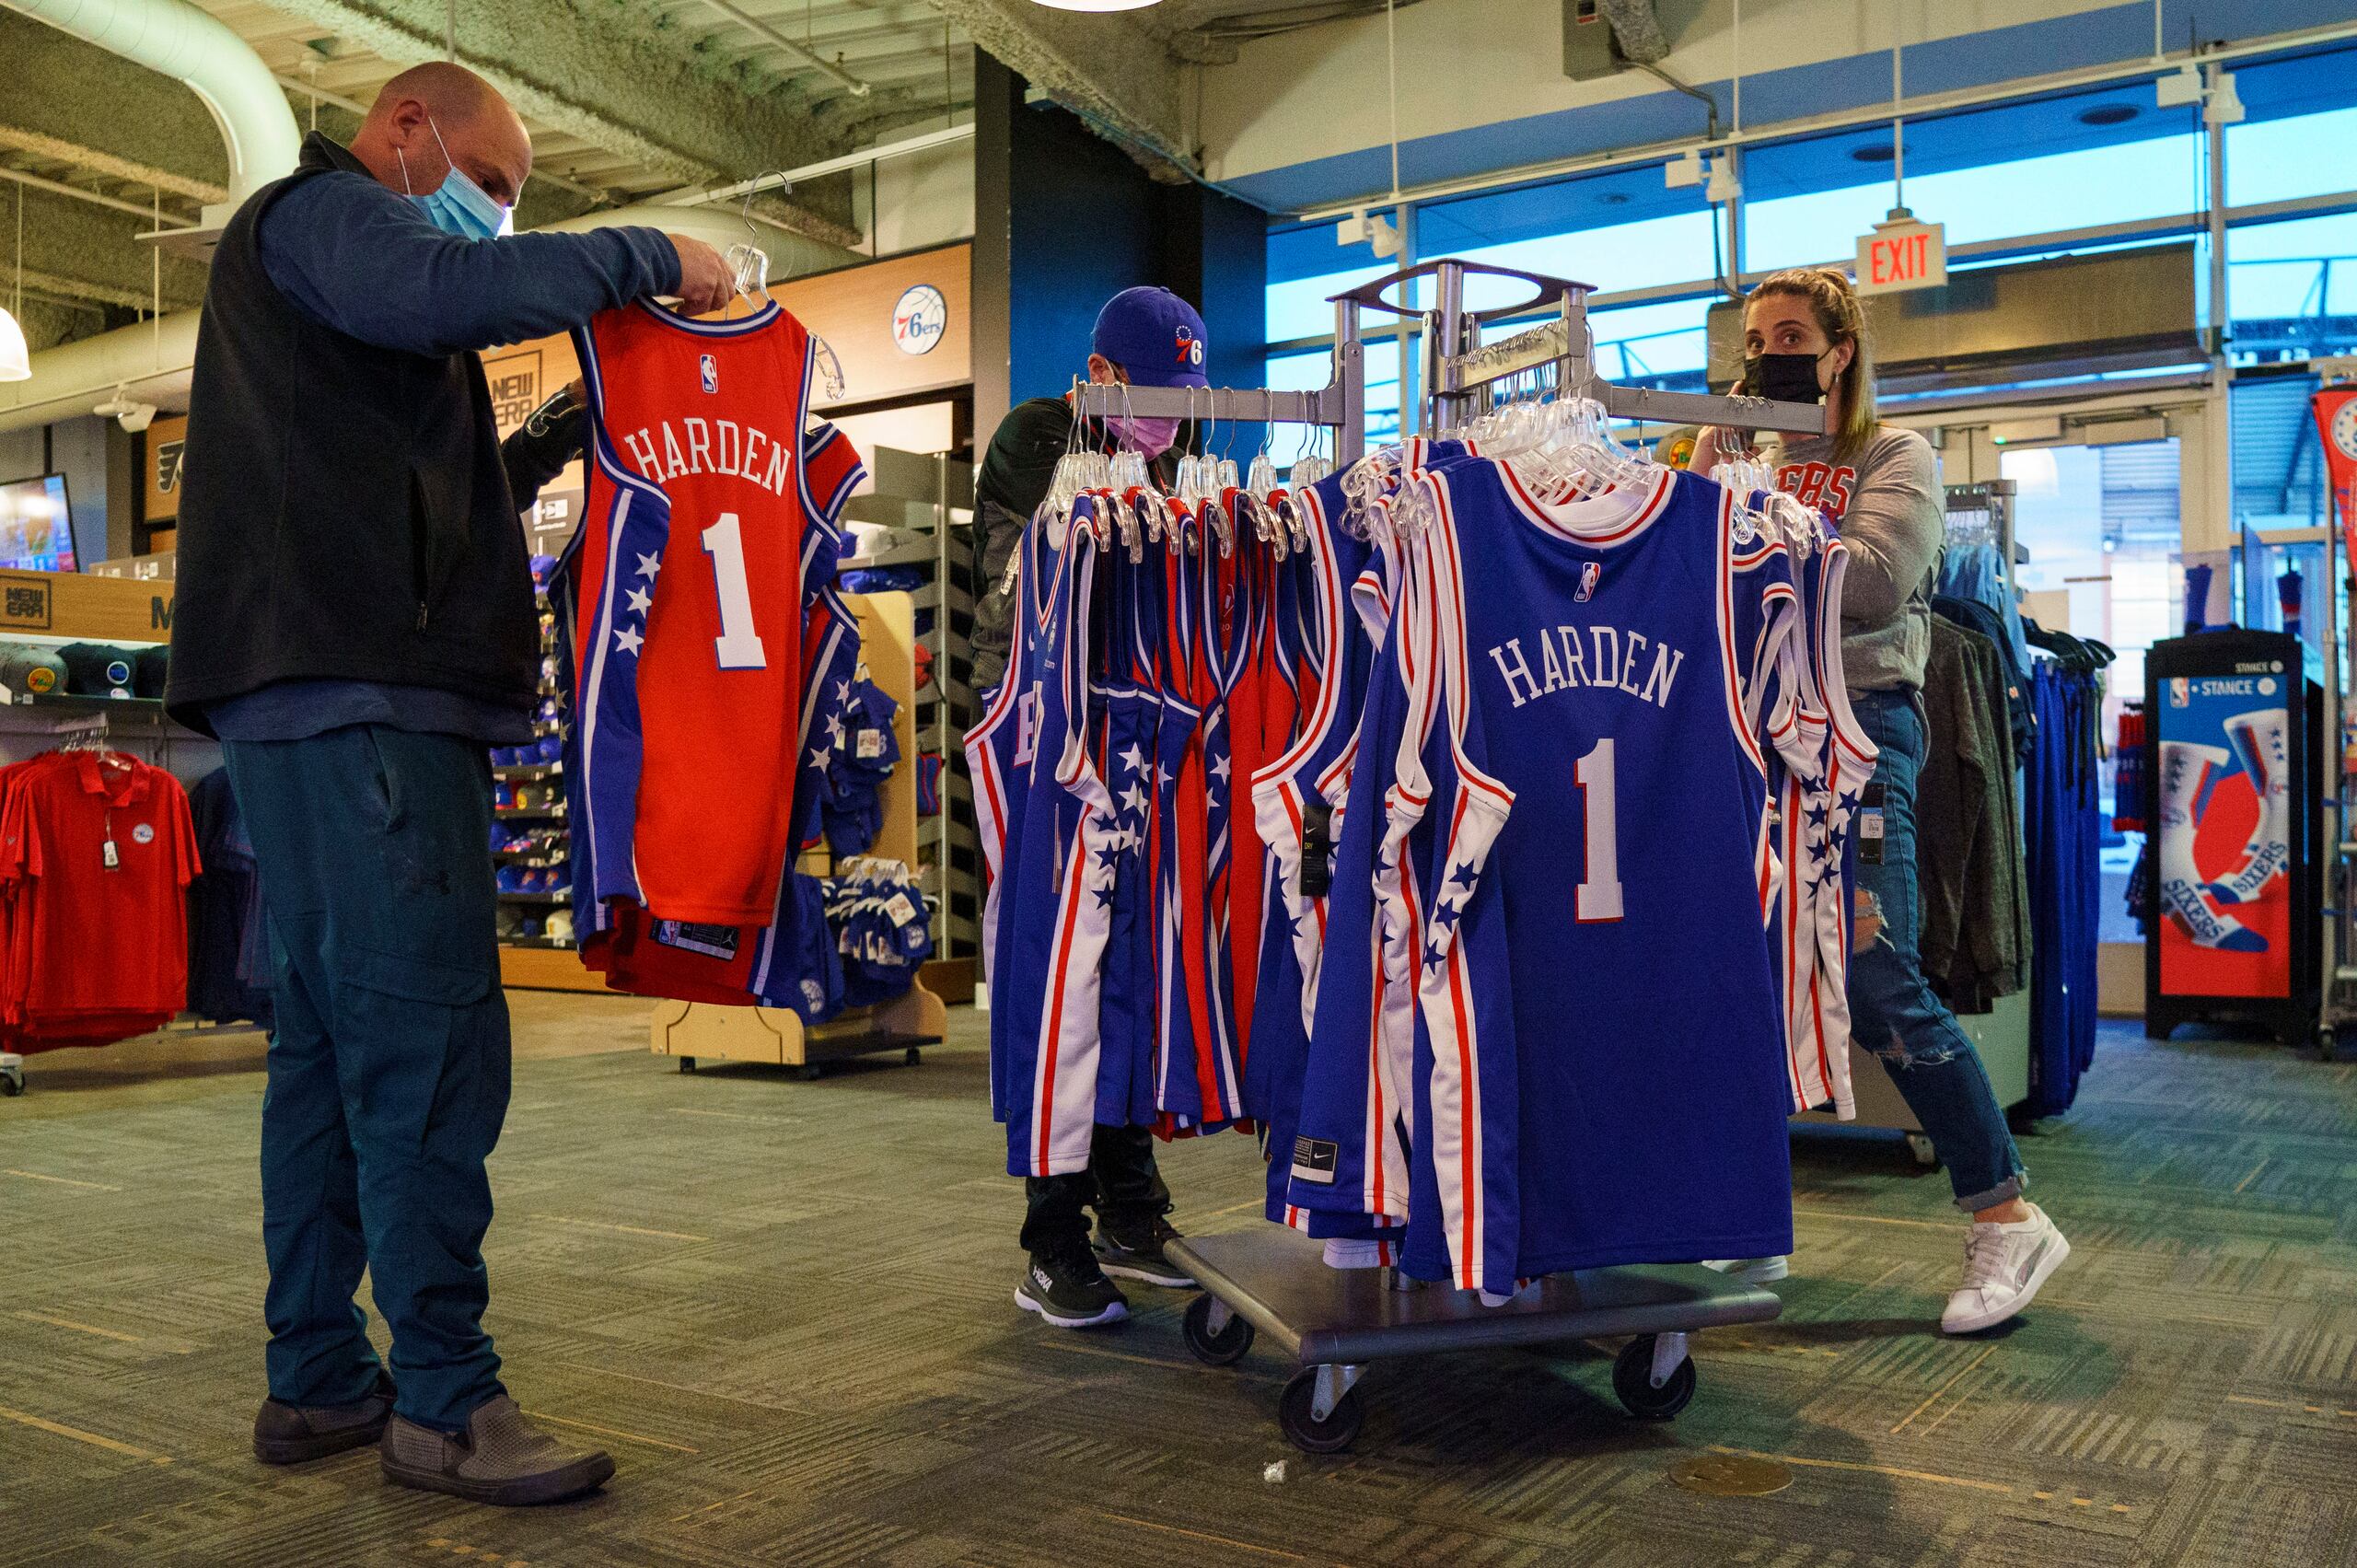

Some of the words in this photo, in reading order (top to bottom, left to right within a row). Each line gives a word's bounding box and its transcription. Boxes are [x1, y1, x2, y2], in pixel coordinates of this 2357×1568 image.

[1870, 233, 1931, 285] EXIT
[897, 312, 941, 340] 76ers
[1175, 337, 1202, 366] 76
[492, 371, 534, 401] NEW
[494, 398, 533, 427] ERA
[623, 417, 792, 498] HARDEN
[6, 587, 44, 603] NEW
[699, 511, 768, 671] 1
[6, 601, 44, 619] ERA
[1488, 625, 1685, 709] HARDEN
[2235, 661, 2270, 674] STANCE
[2201, 679, 2254, 696] STANCE
[1573, 738, 1625, 924] 1
[2232, 840, 2287, 893] SIXERS
[2164, 878, 2225, 939] SIXERS
[1032, 1264, 1053, 1294] HOKA
